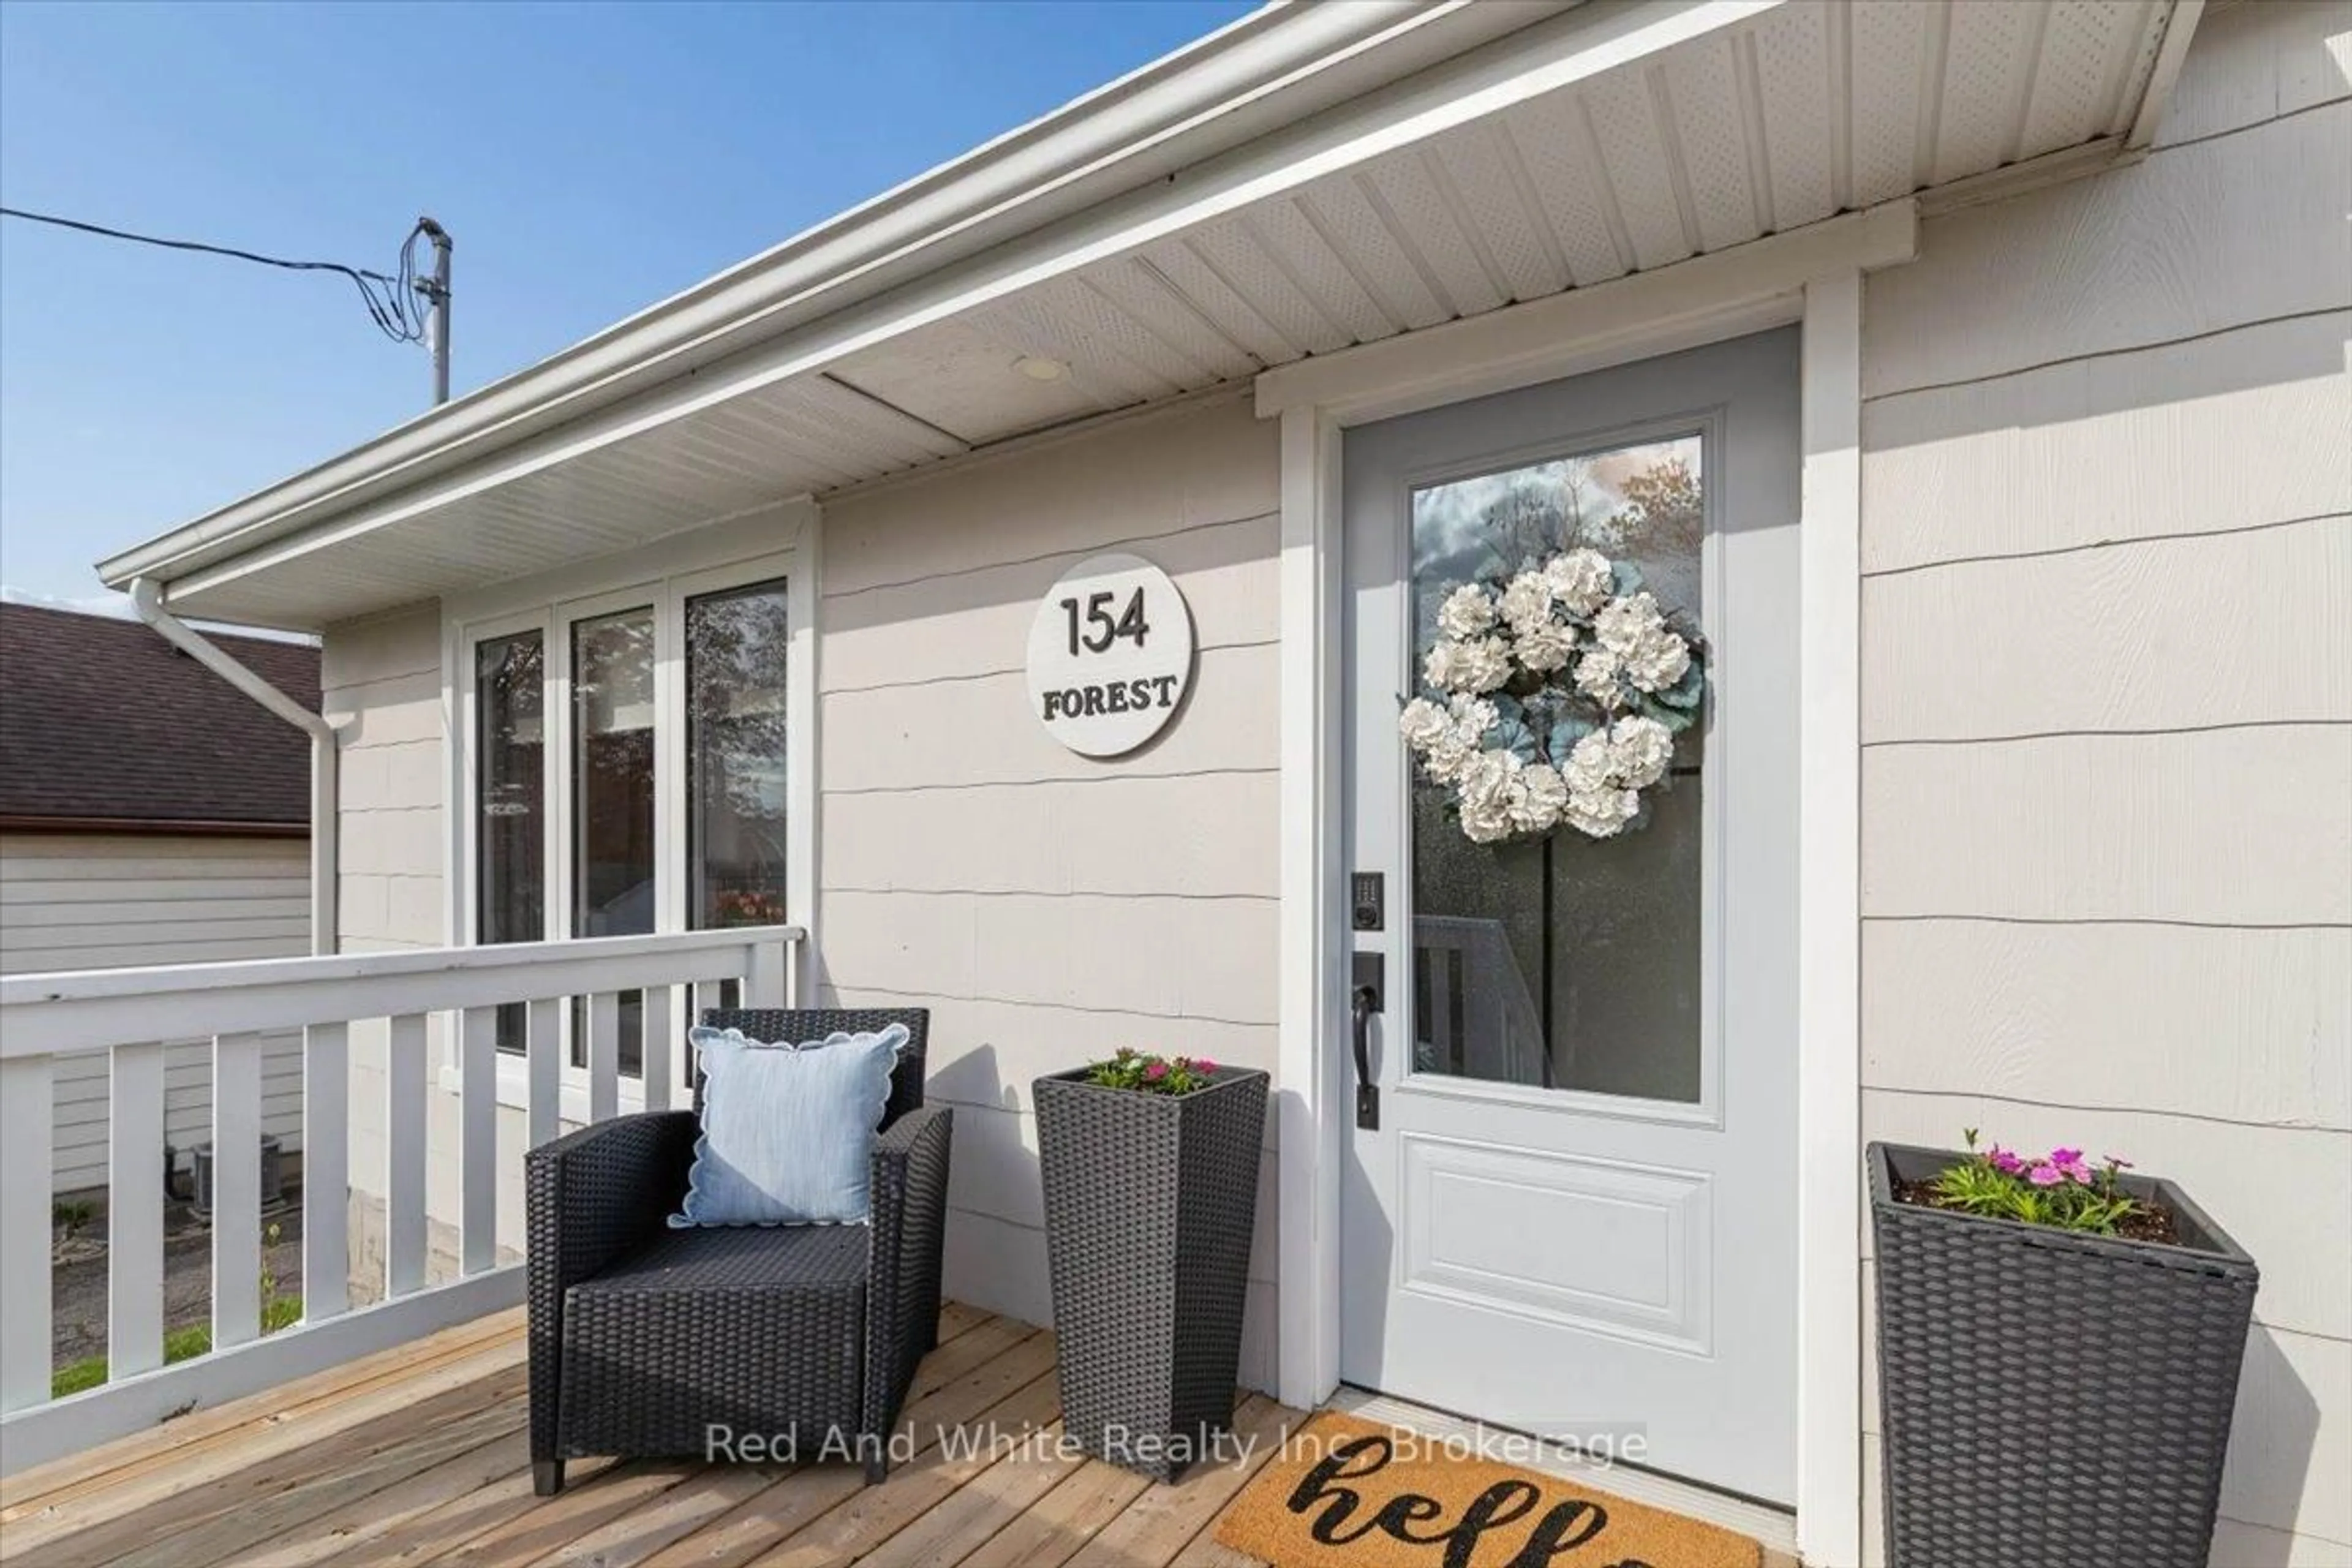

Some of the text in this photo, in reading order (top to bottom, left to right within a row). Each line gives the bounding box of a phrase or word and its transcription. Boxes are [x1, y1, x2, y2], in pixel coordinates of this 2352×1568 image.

[1060, 586, 1150, 657] 154
[1042, 675, 1177, 721] FOREST
[1287, 1436, 1656, 1568] hell
